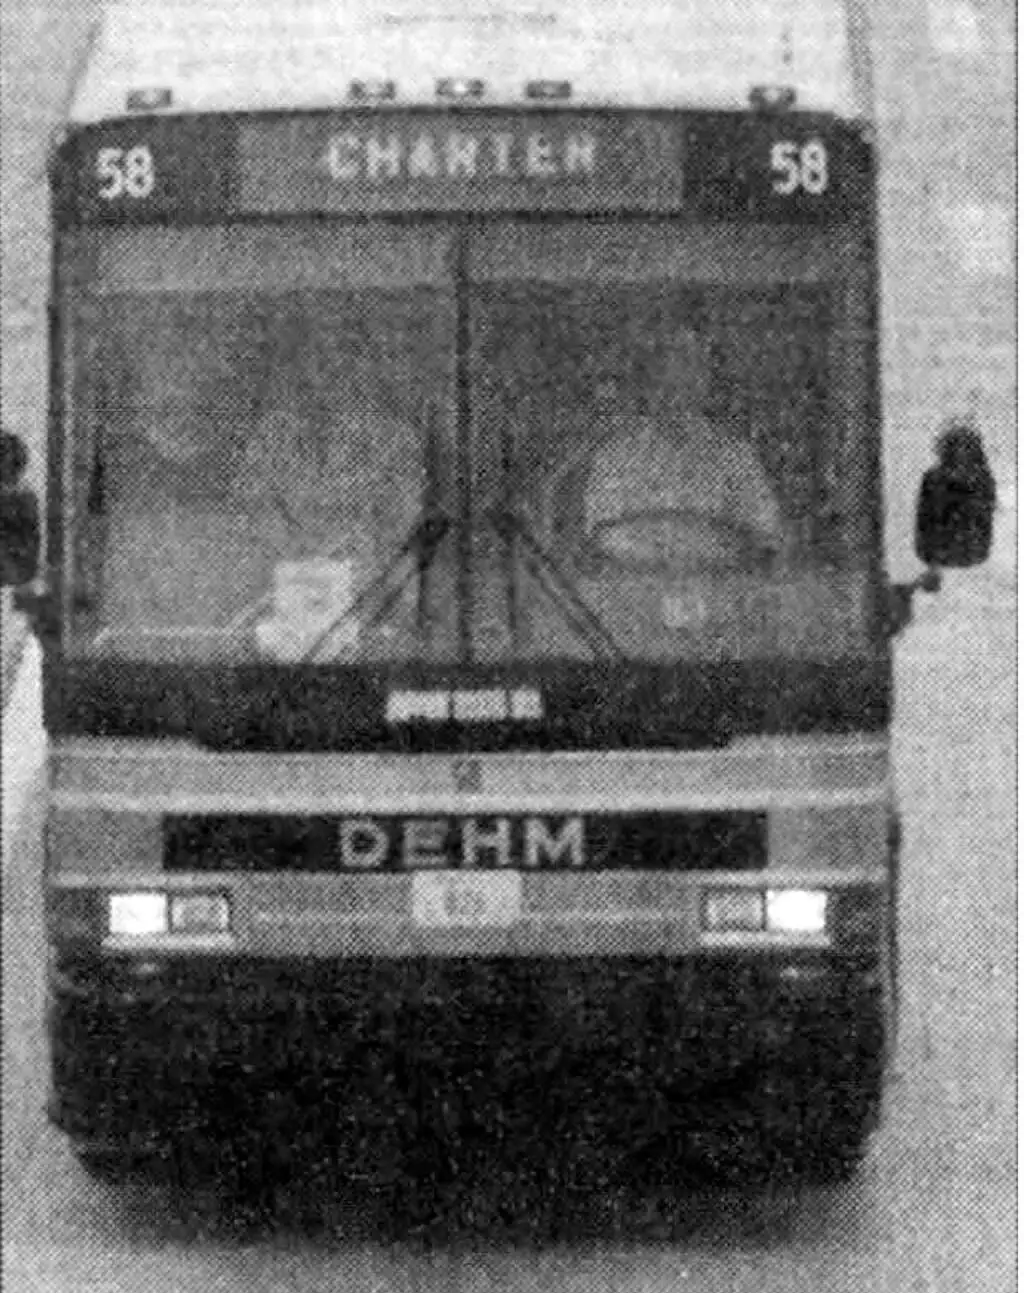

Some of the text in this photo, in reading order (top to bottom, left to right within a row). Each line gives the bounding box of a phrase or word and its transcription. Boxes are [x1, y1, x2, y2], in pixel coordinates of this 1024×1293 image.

[95, 146, 155, 199] 58
[327, 134, 597, 180] CHARTER
[770, 141, 828, 194] 58
[339, 817, 587, 868] DEHM
